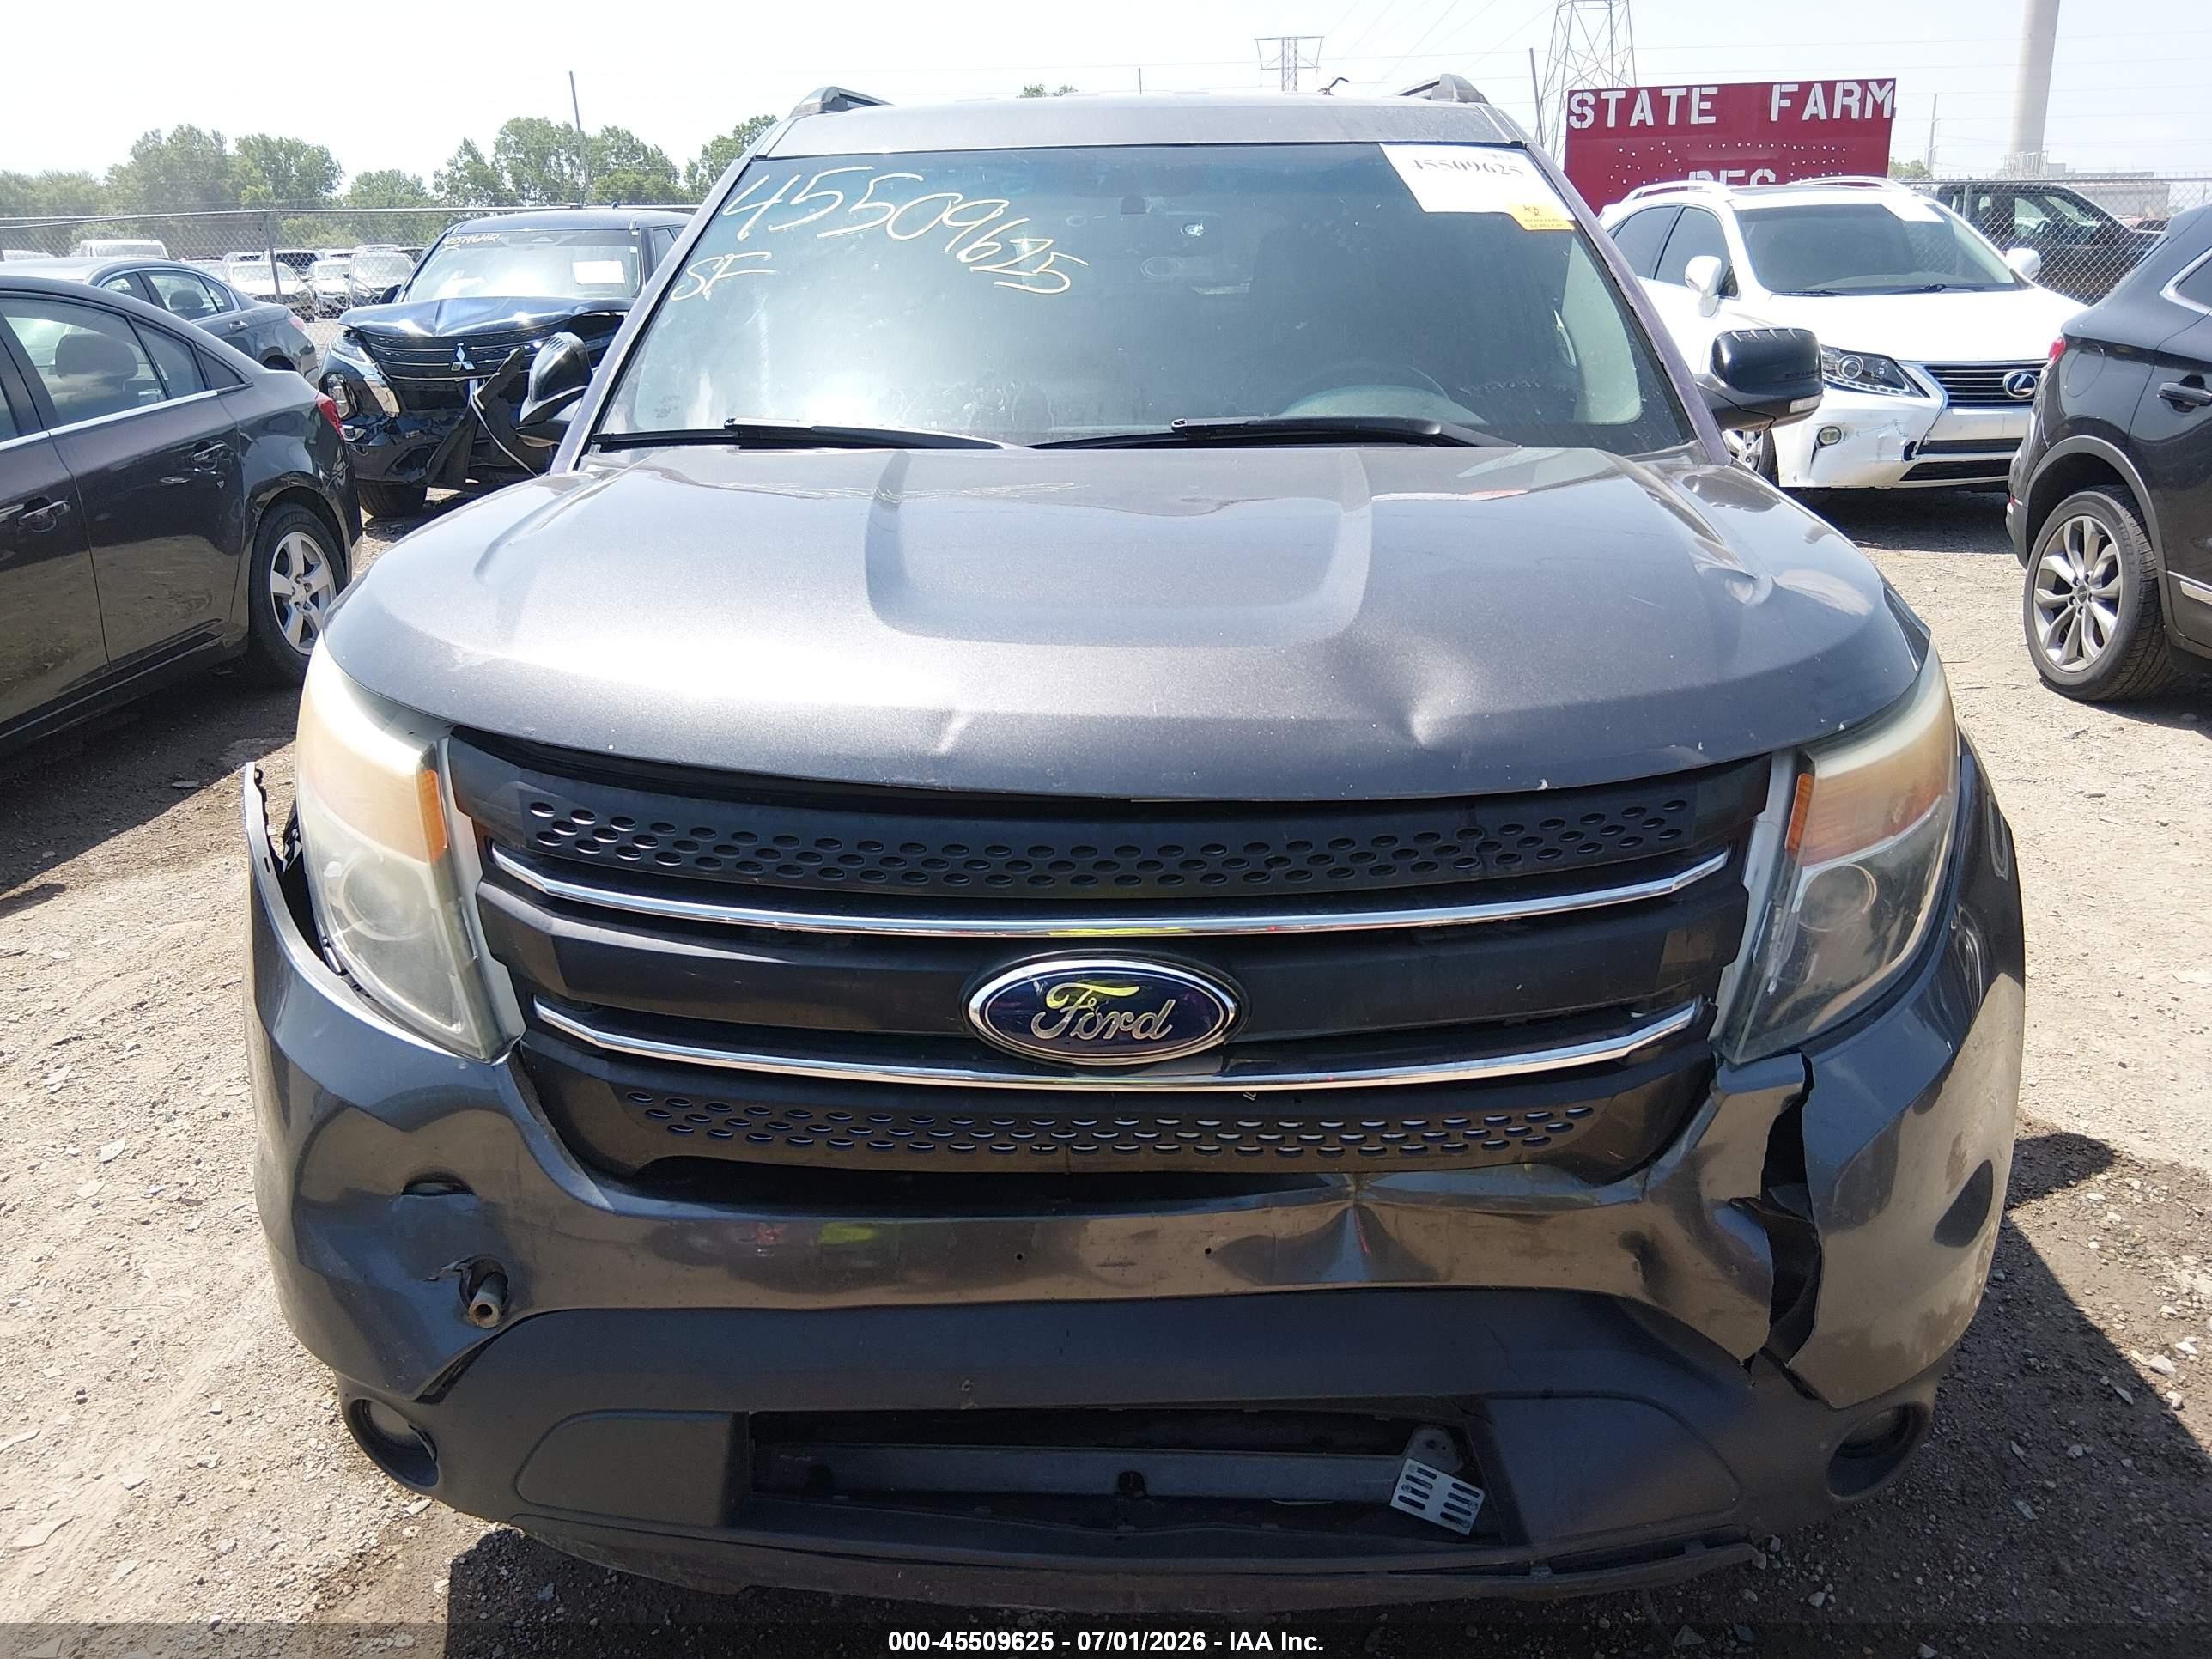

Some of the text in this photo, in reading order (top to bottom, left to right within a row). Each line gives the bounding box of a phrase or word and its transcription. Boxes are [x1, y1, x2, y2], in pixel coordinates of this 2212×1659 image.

[1568, 81, 1893, 129] STATE FARM
[723, 166, 1090, 294] 45509625
[670, 251, 777, 301] SF
[1030, 982, 1176, 1040] Ford
